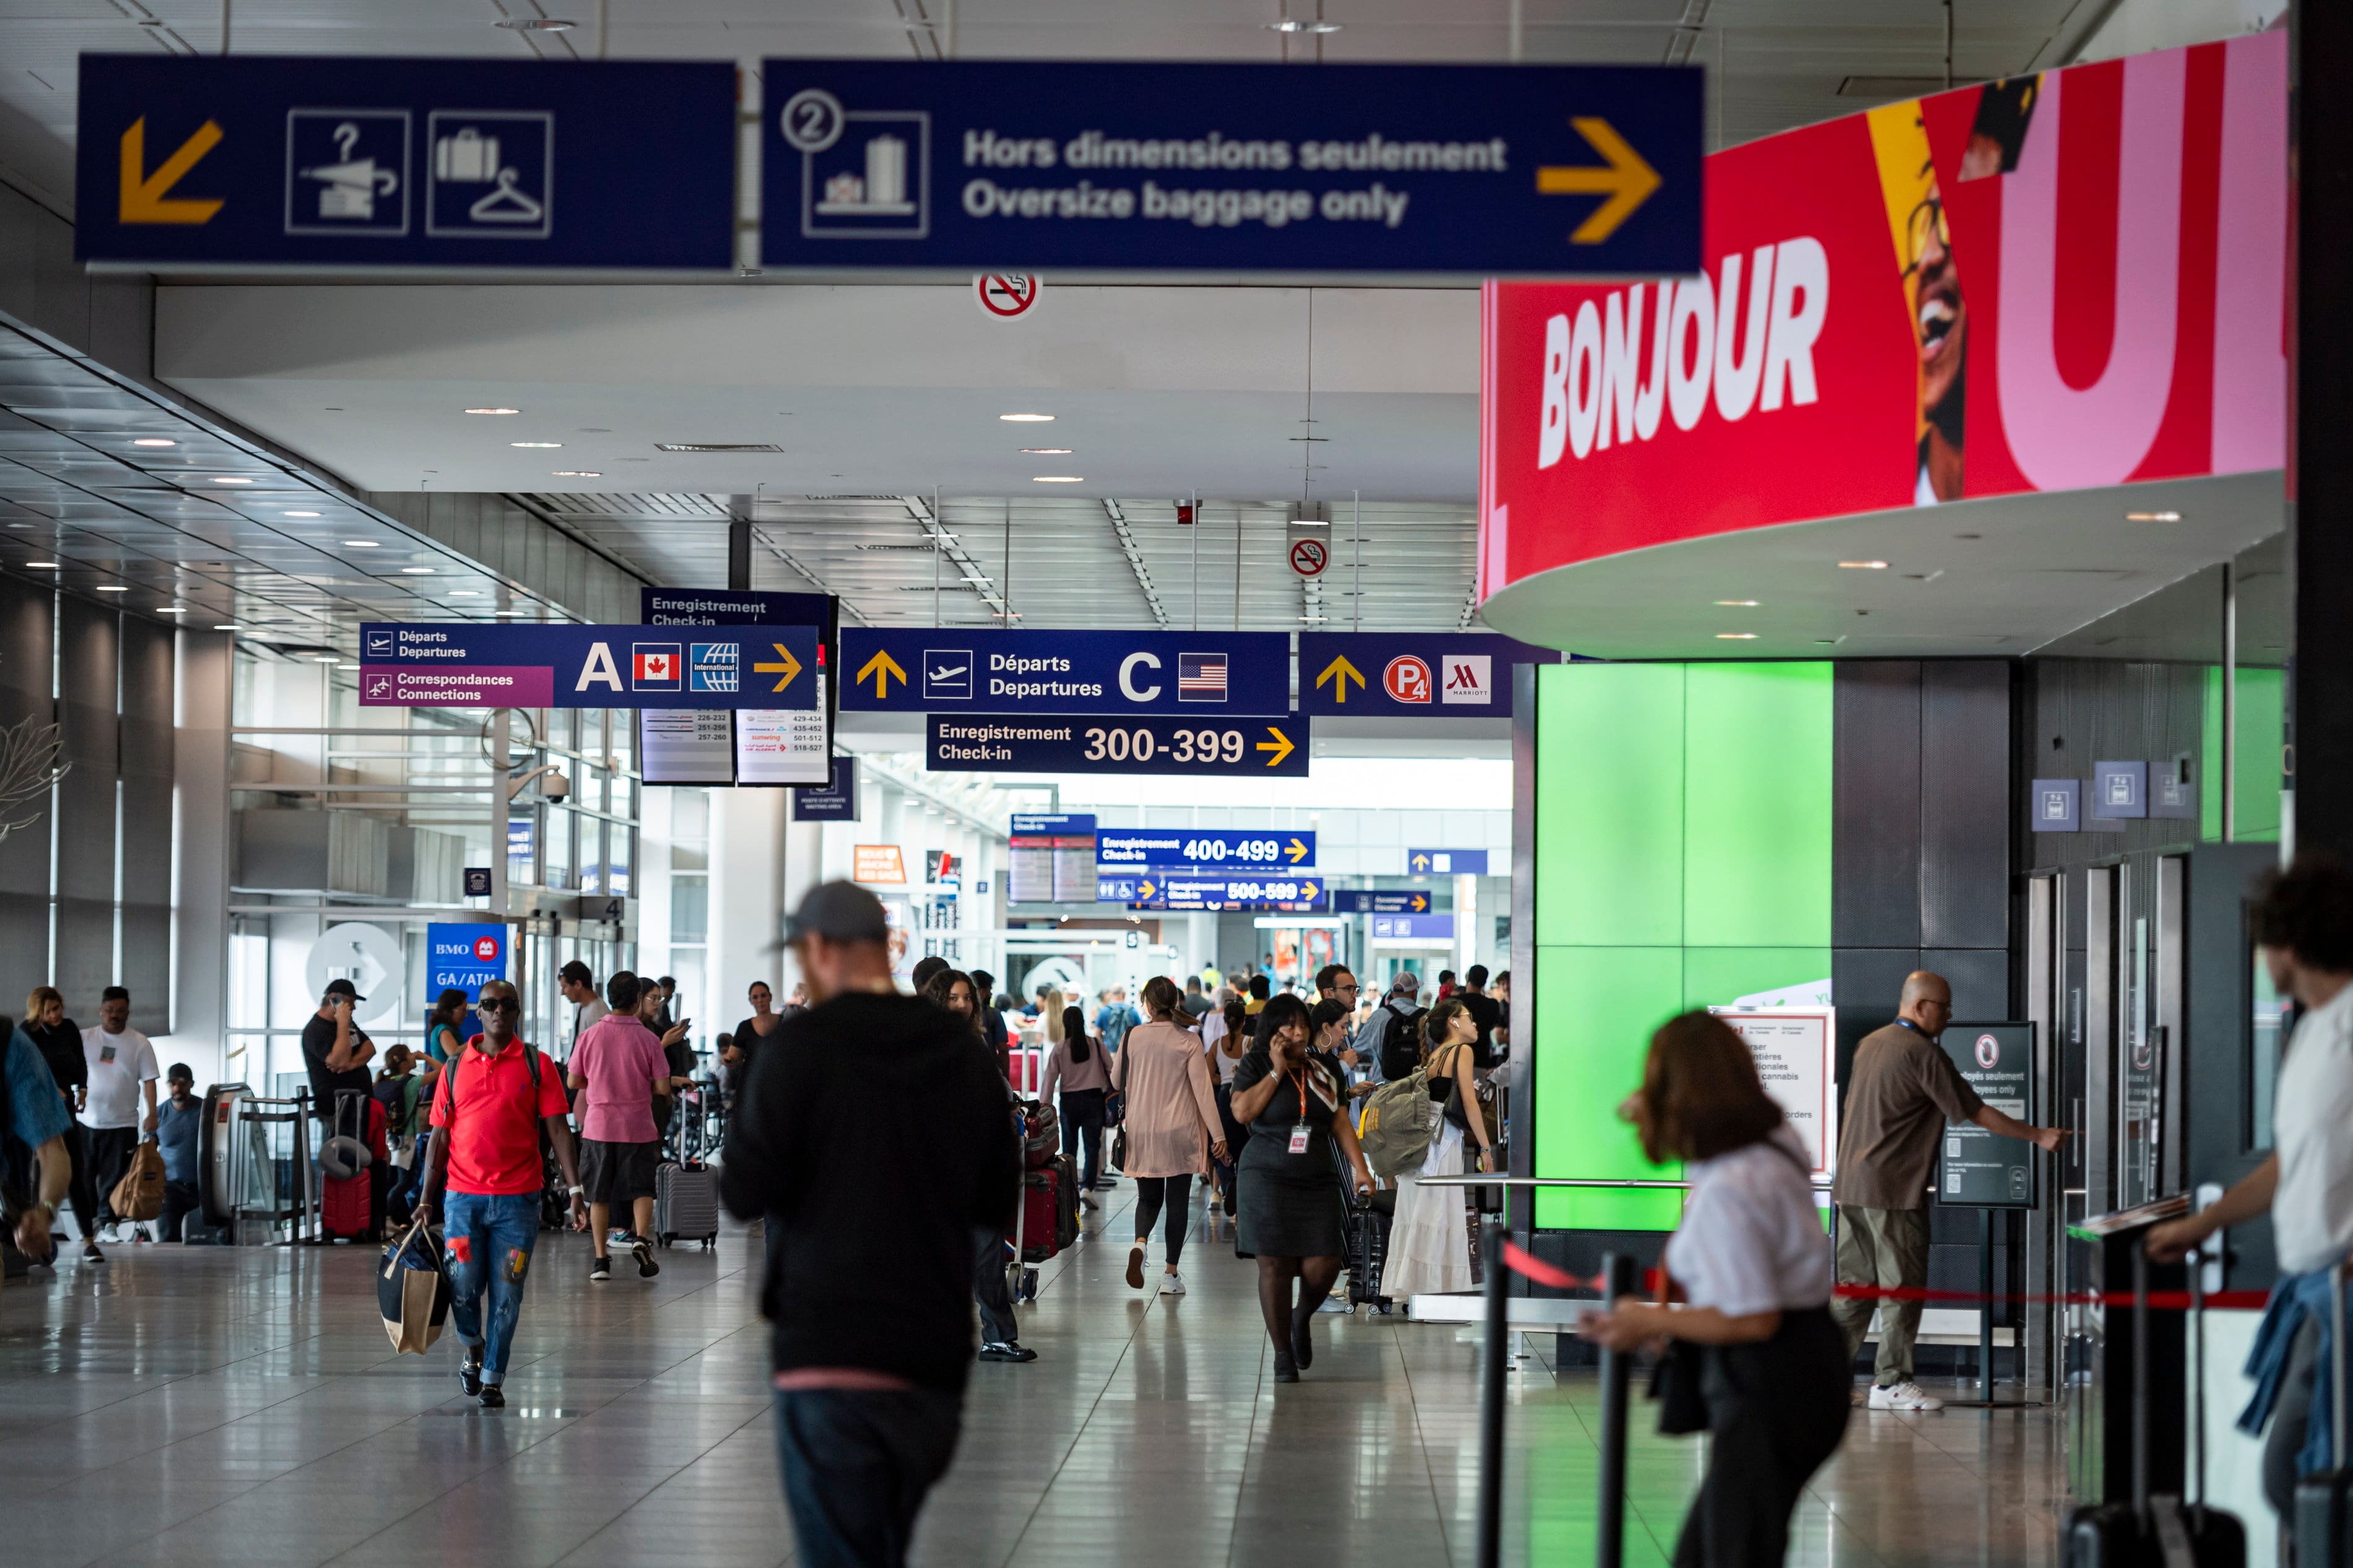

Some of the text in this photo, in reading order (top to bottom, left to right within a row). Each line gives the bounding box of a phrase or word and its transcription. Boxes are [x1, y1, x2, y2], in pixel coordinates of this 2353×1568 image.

[798, 103, 824, 137] 2
[963, 129, 1507, 172] Hors dimensions seulement
[962, 178, 1409, 228] Oversize baggage only
[1538, 235, 1830, 470] BONJOUR
[652, 597, 767, 614] Enregistrement
[652, 615, 716, 626] Check-in
[399, 630, 448, 644] Départs
[399, 646, 466, 660] Departures
[575, 642, 624, 692] A
[694, 664, 735, 672] International
[989, 653, 1071, 675] Départs
[397, 672, 514, 689] Correspondances
[1118, 651, 1162, 703] C
[397, 688, 482, 701] Connections
[989, 678, 1103, 700] Departures
[939, 723, 1072, 745] Enregistrement
[939, 743, 1012, 761] Check-in
[1084, 727, 1245, 764] 300-399
[1102, 837, 1180, 851] Enregistrement
[1183, 839, 1279, 861] 400-499
[1102, 849, 1146, 860] Check-in
[1227, 882, 1298, 900] 500-599
[605, 899, 620, 917] 4
[436, 944, 469, 955] BMO
[437, 972, 495, 986] GA/ATM
[1753, 1052, 1782, 1060] ntières
[1960, 1071, 2025, 1082] loyés seulement
[1973, 1085, 2016, 1096] loyees only
[1783, 1111, 1813, 1119] orders
